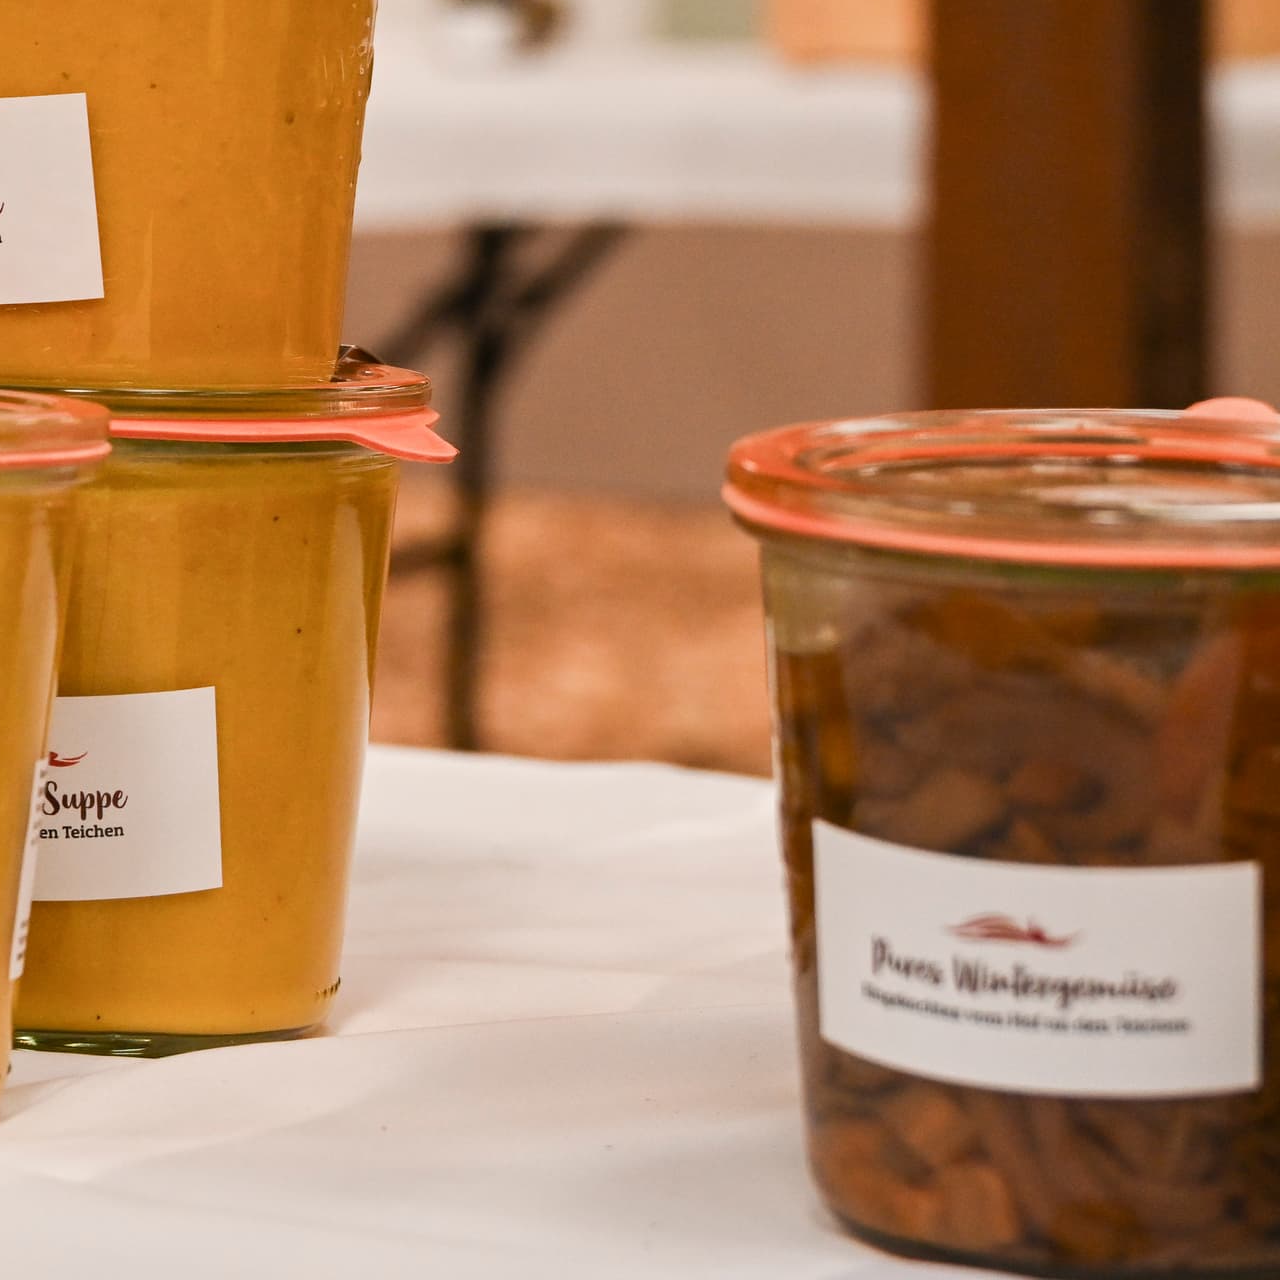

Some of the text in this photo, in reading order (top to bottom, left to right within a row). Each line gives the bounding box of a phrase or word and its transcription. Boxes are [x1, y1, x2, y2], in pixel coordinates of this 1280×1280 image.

[42, 780, 128, 821] Suppe
[40, 824, 125, 839] en Teichen
